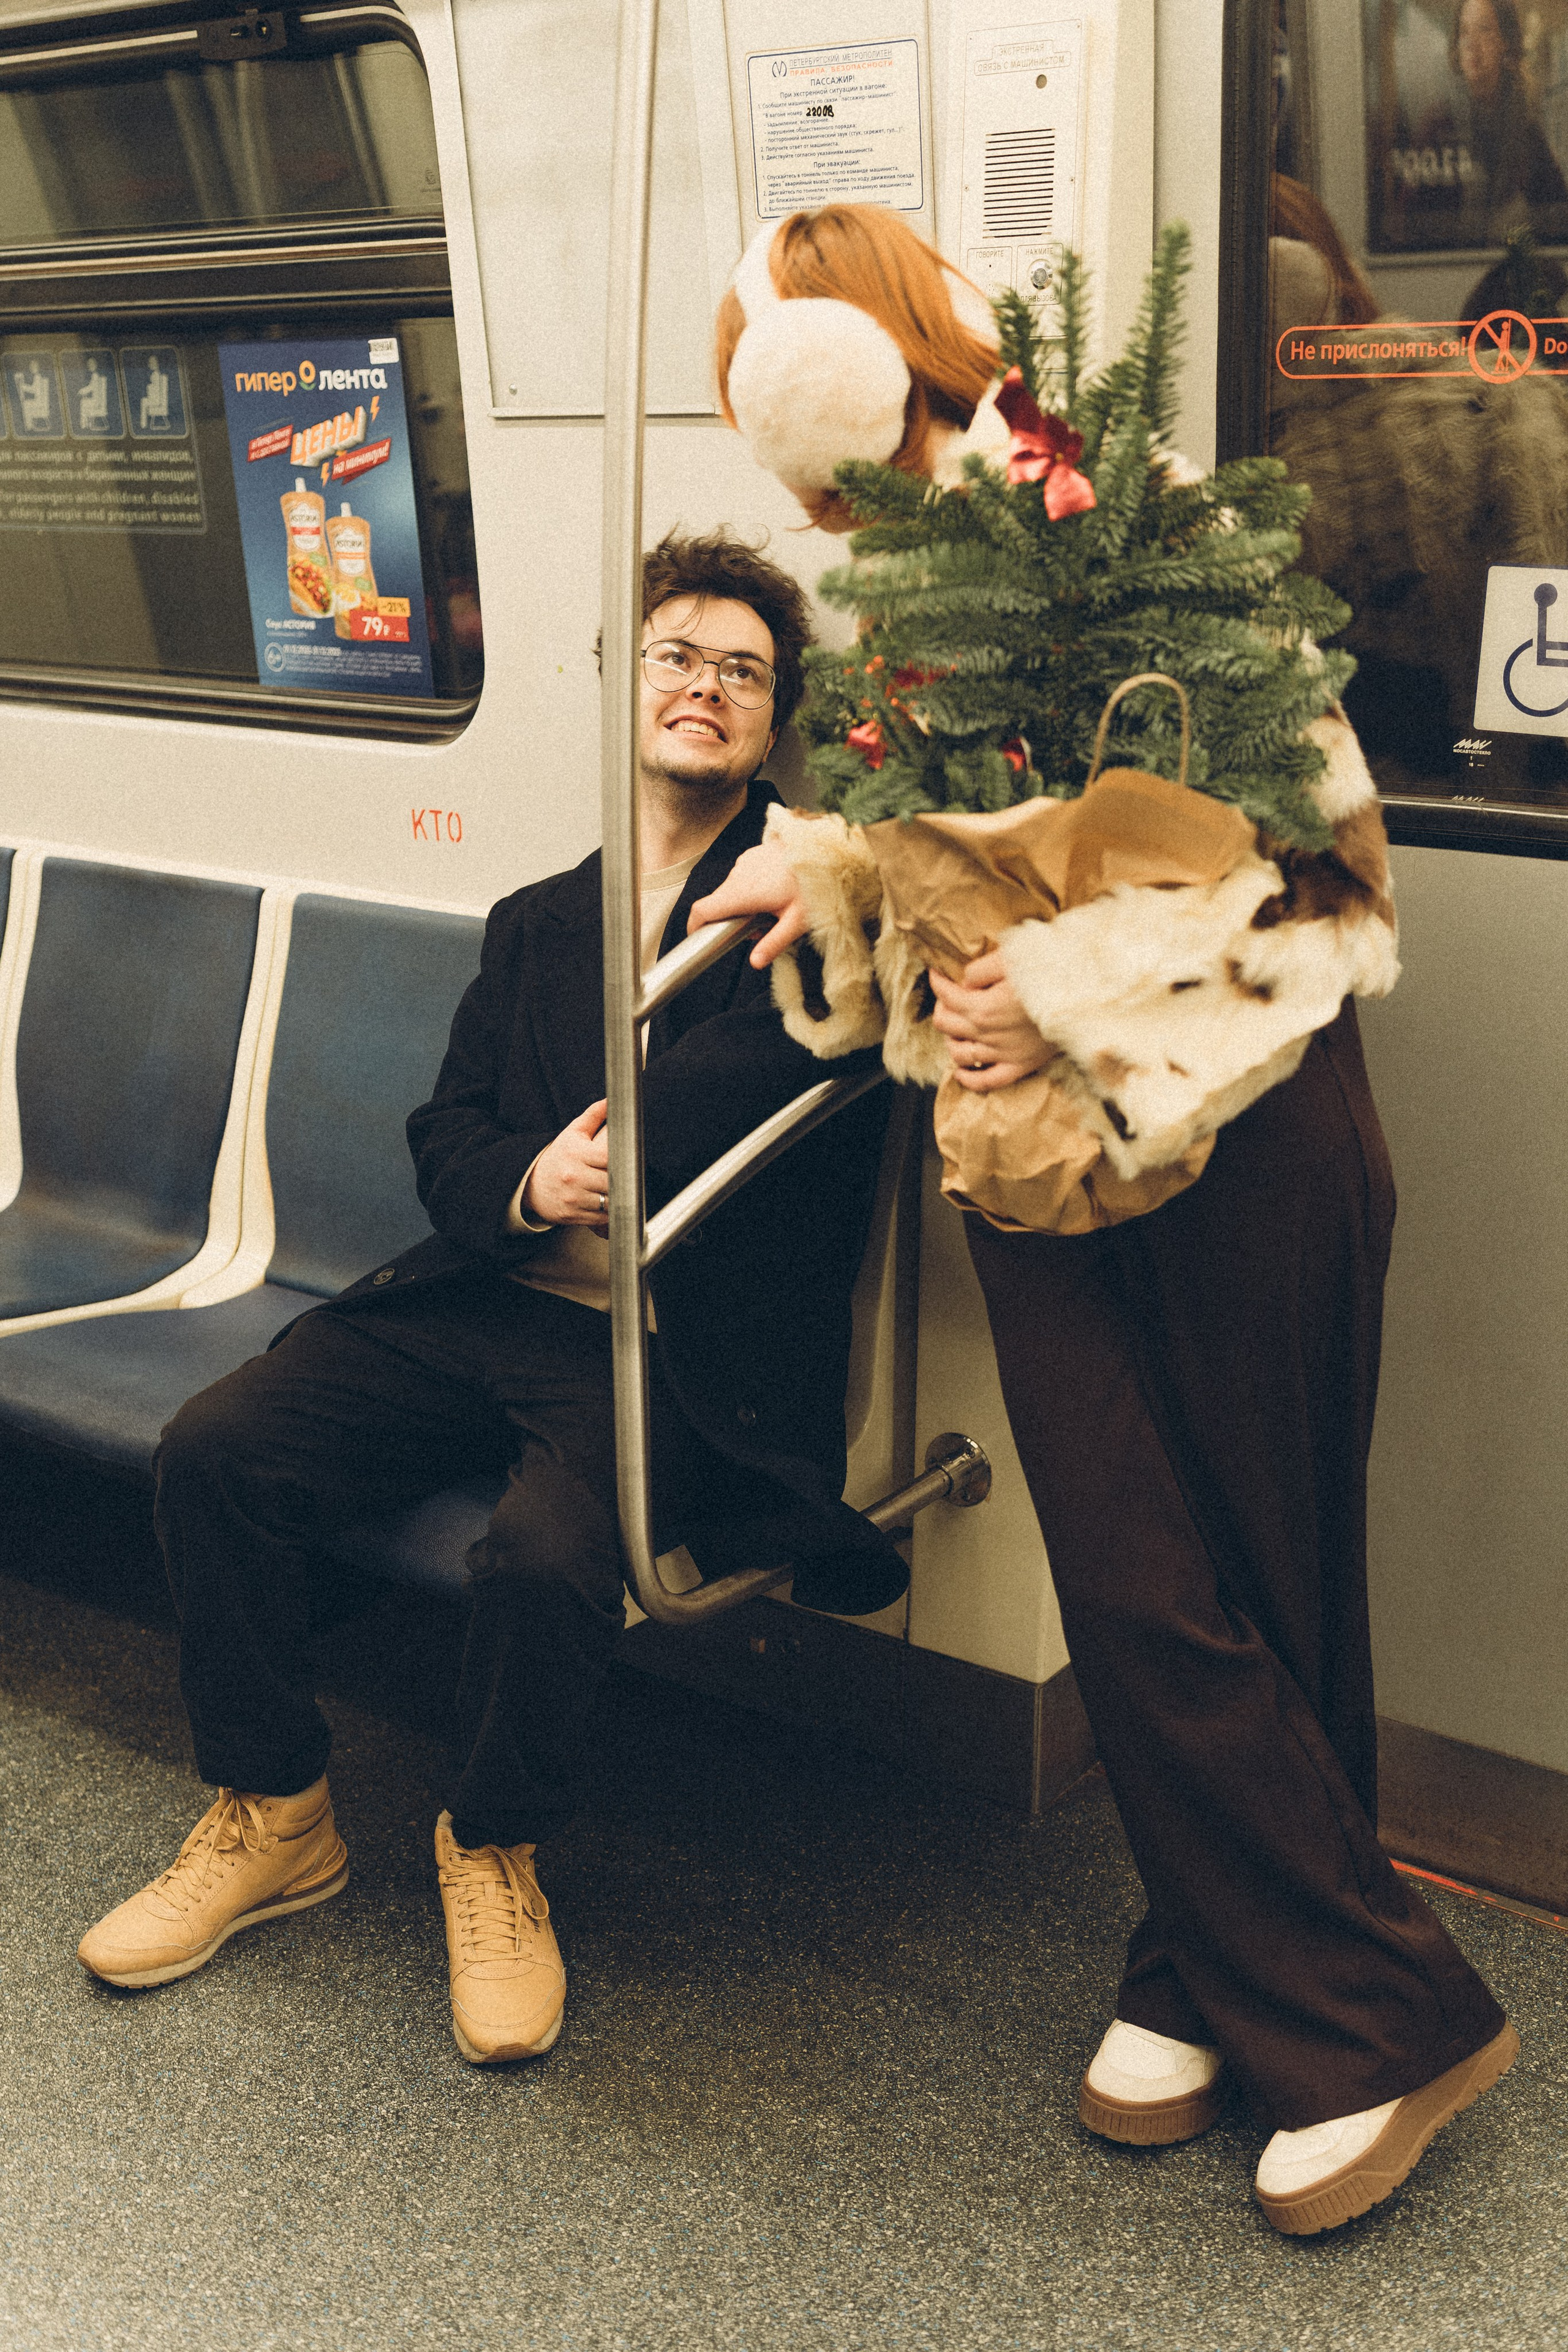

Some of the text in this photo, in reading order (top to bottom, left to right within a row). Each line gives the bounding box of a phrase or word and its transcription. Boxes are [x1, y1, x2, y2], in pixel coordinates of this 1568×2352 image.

[1000, 43, 1044, 56] ЭКСТРЕННАЯ
[790, 49, 892, 67] ПЕТЕРБУРГСКИЙ МЕТРОПОЛИТЕН
[978, 62, 1001, 72] СВЯЗЬ
[1010, 55, 1065, 69] МАШИНИСТОМ
[790, 61, 893, 76] ПРАВИЛА БЕЗОПАСНОСТИ
[810, 75, 855, 86] ПАССАЖИР!
[793, 88, 827, 99] экстренной
[829, 86, 858, 94] ситуации
[827, 159, 861, 168] эвакуации:
[976, 250, 1004, 258] ГОВОРИТЕ
[1291, 337, 1466, 365] Не прислоняться!
[1544, 337, 1568, 355] Do
[235, 368, 388, 397] гипер лента
[290, 405, 367, 467] ЦЕНЫ
[333, 461, 345, 475] на
[412, 809, 462, 843] КТО
